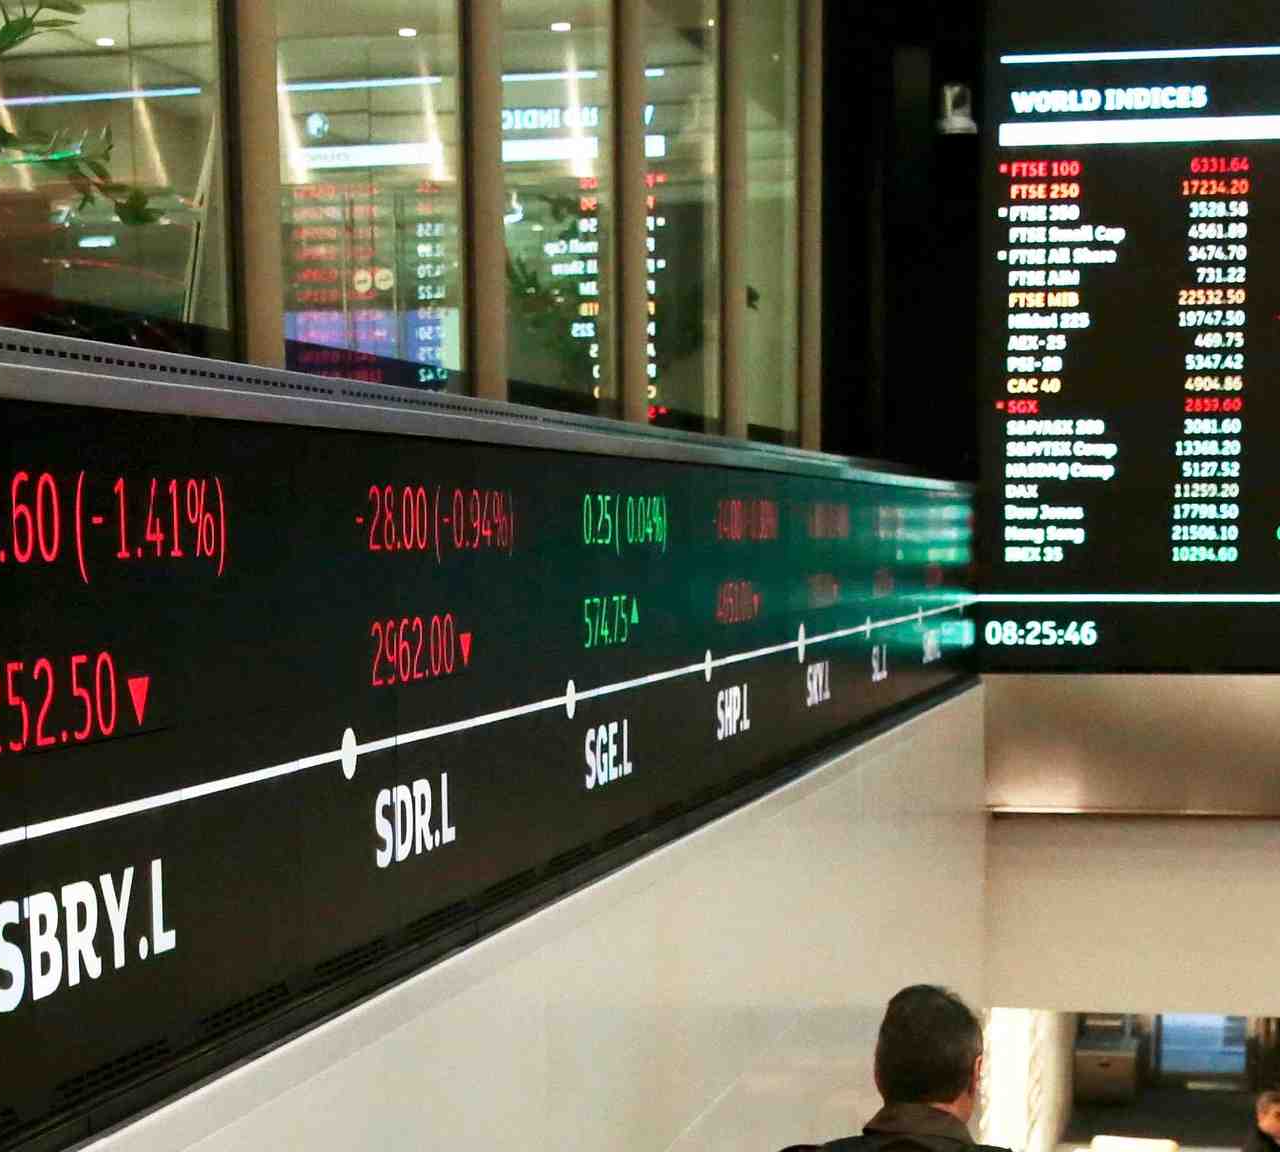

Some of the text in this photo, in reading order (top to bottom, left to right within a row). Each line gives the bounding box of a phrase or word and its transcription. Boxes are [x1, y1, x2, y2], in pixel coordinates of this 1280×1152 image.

[1011, 86, 1208, 113] WORLD INDICES
[1011, 160, 1081, 177] FTSE 100
[1011, 183, 1079, 199] FTSE 250
[1049, 204, 1080, 221] 30
[1095, 225, 1125, 244] Cp
[1072, 247, 1117, 264] She
[1009, 292, 1045, 307] FTSE
[1007, 378, 1061, 393] CAC 40
[1008, 400, 1038, 413] SGX
[1185, 398, 1242, 412] 28.60
[1075, 419, 1104, 435] 20
[1184, 418, 1241, 434] 301.60
[1073, 441, 1117, 459] Cp
[1176, 440, 1241, 456] 133.20
[1006, 462, 1115, 480] NAAQ Cp
[356, 485, 428, 550] -28.00
[1005, 505, 1038, 520] Dw
[75, 472, 226, 582] (-1.41%)
[985, 621, 1097, 645] 08:25:46
[372, 614, 454, 686] 2962.00
[585, 719, 632, 789] SGE.L
[376, 773, 455, 867] SDR.L
